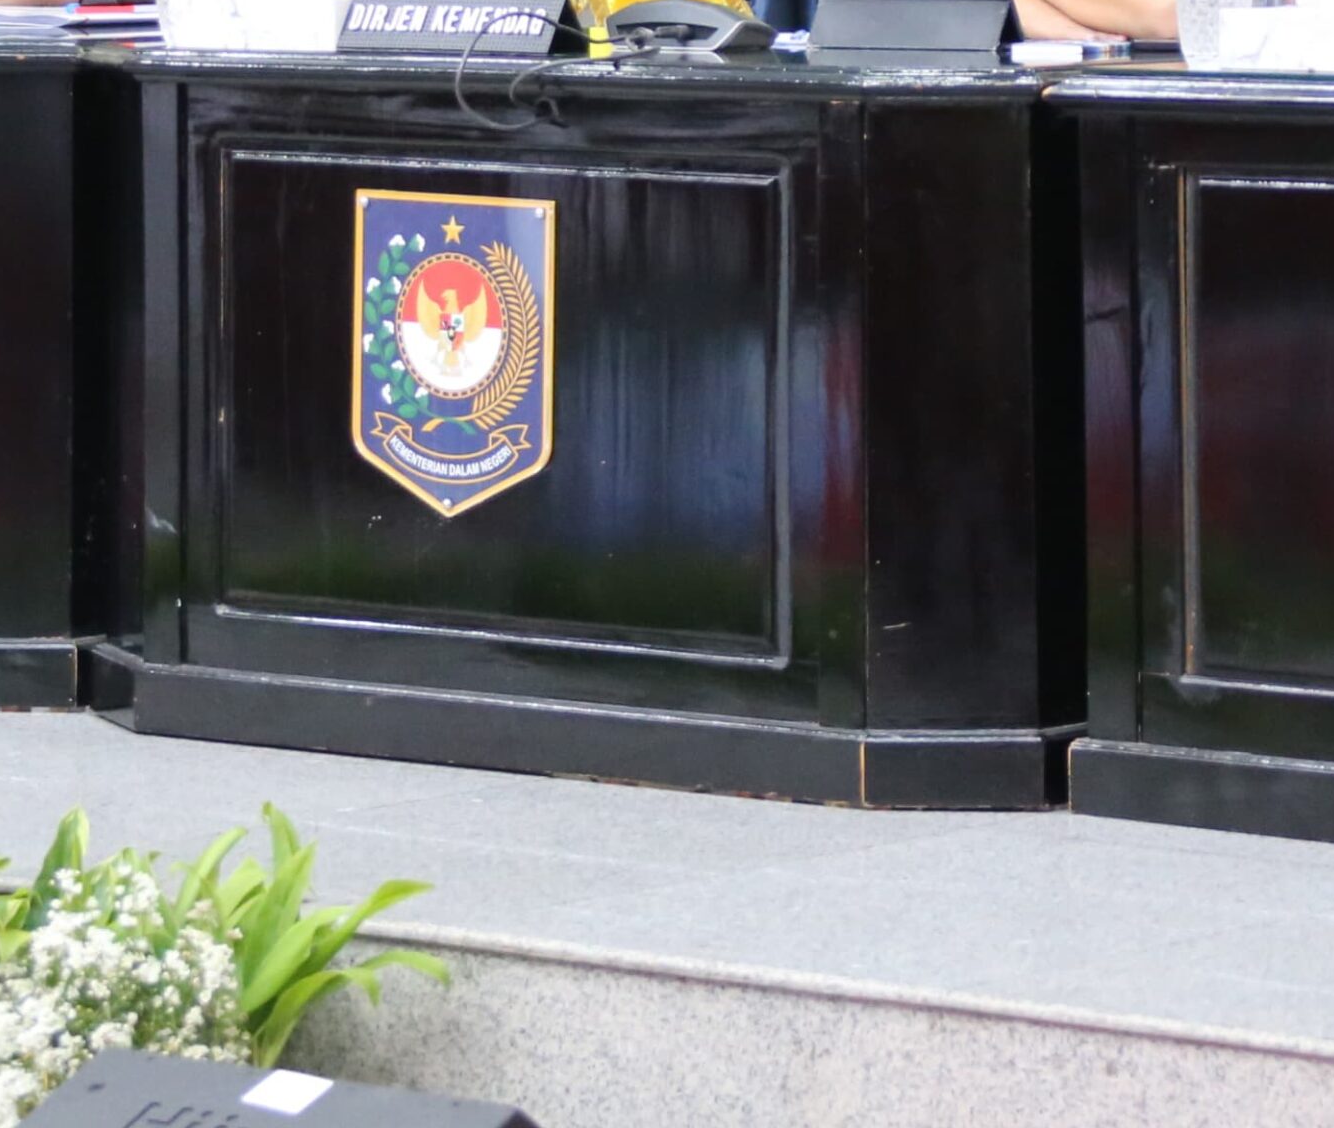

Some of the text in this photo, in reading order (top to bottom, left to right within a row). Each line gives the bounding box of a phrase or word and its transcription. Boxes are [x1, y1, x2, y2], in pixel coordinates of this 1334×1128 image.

[348, 3, 547, 36] DIRJEN KEMENDAG
[389, 435, 513, 477] KEMENTERIAN DALAM NEGERI
